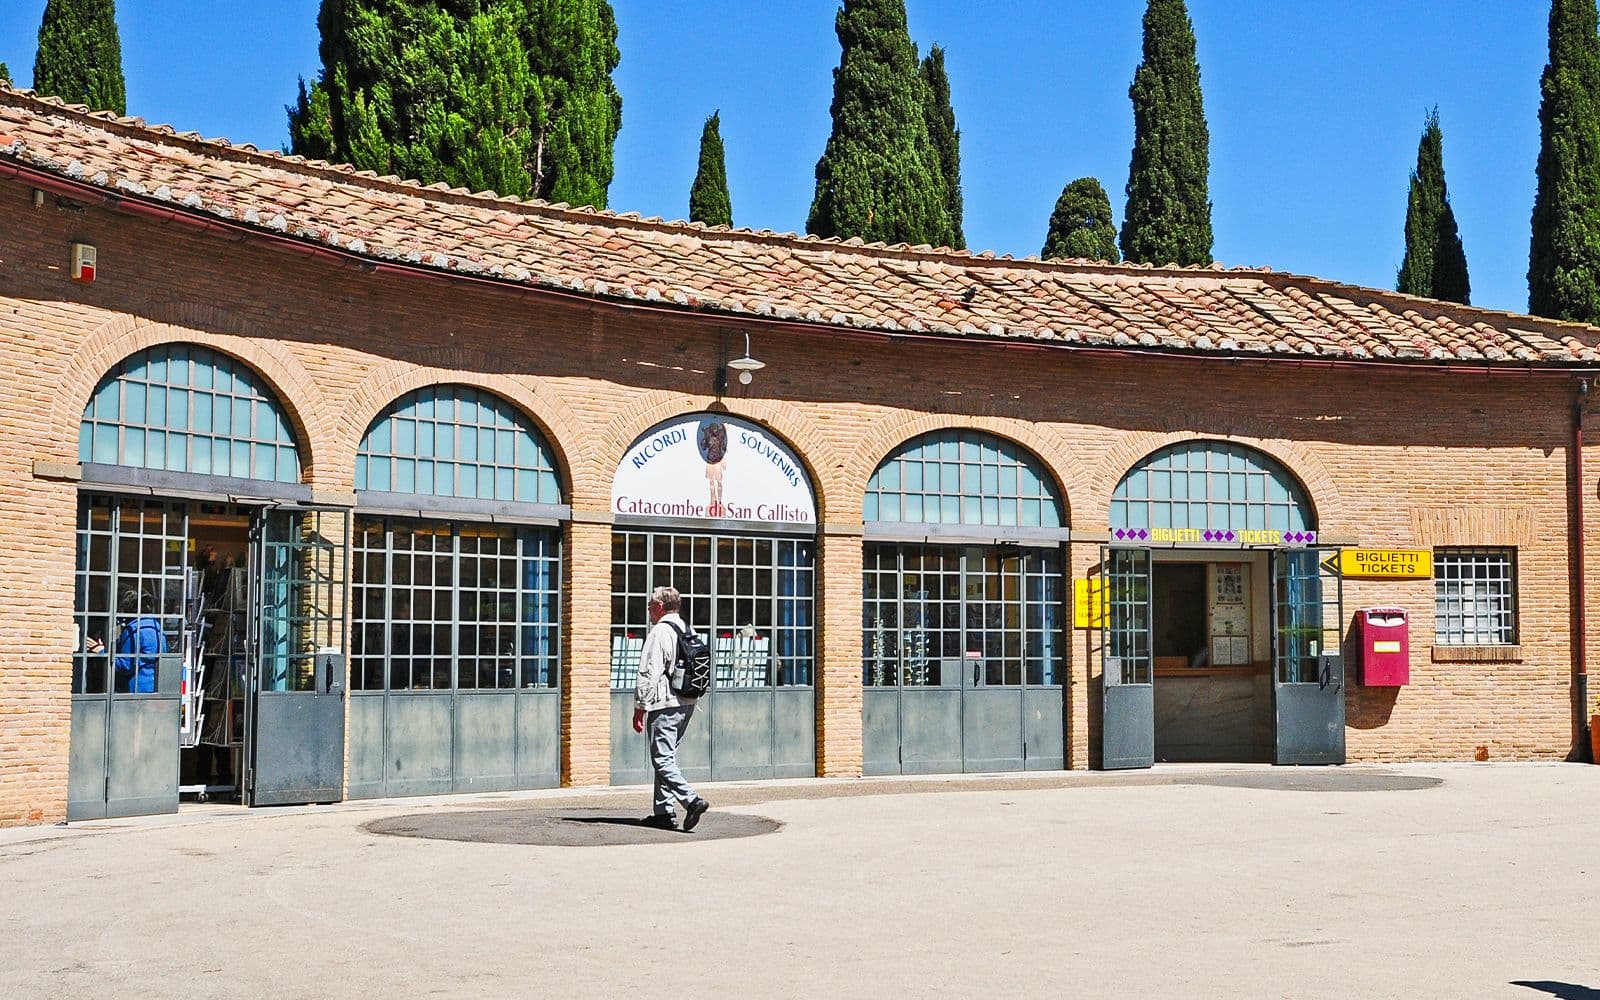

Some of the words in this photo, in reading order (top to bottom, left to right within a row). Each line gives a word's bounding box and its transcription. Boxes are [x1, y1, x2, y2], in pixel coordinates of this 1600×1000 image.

[632, 428, 687, 469] RICORDI
[739, 431, 801, 487] SOUVENIRS
[616, 496, 704, 517] Catacombe
[708, 500, 723, 517] di
[727, 502, 752, 519] San
[757, 503, 808, 522] Callisto
[1151, 527, 1200, 543] BIGLIETTI
[1237, 529, 1281, 544] TICKETS
[1355, 552, 1419, 562] BIGLIETTI
[1359, 563, 1415, 574] TICKETS
